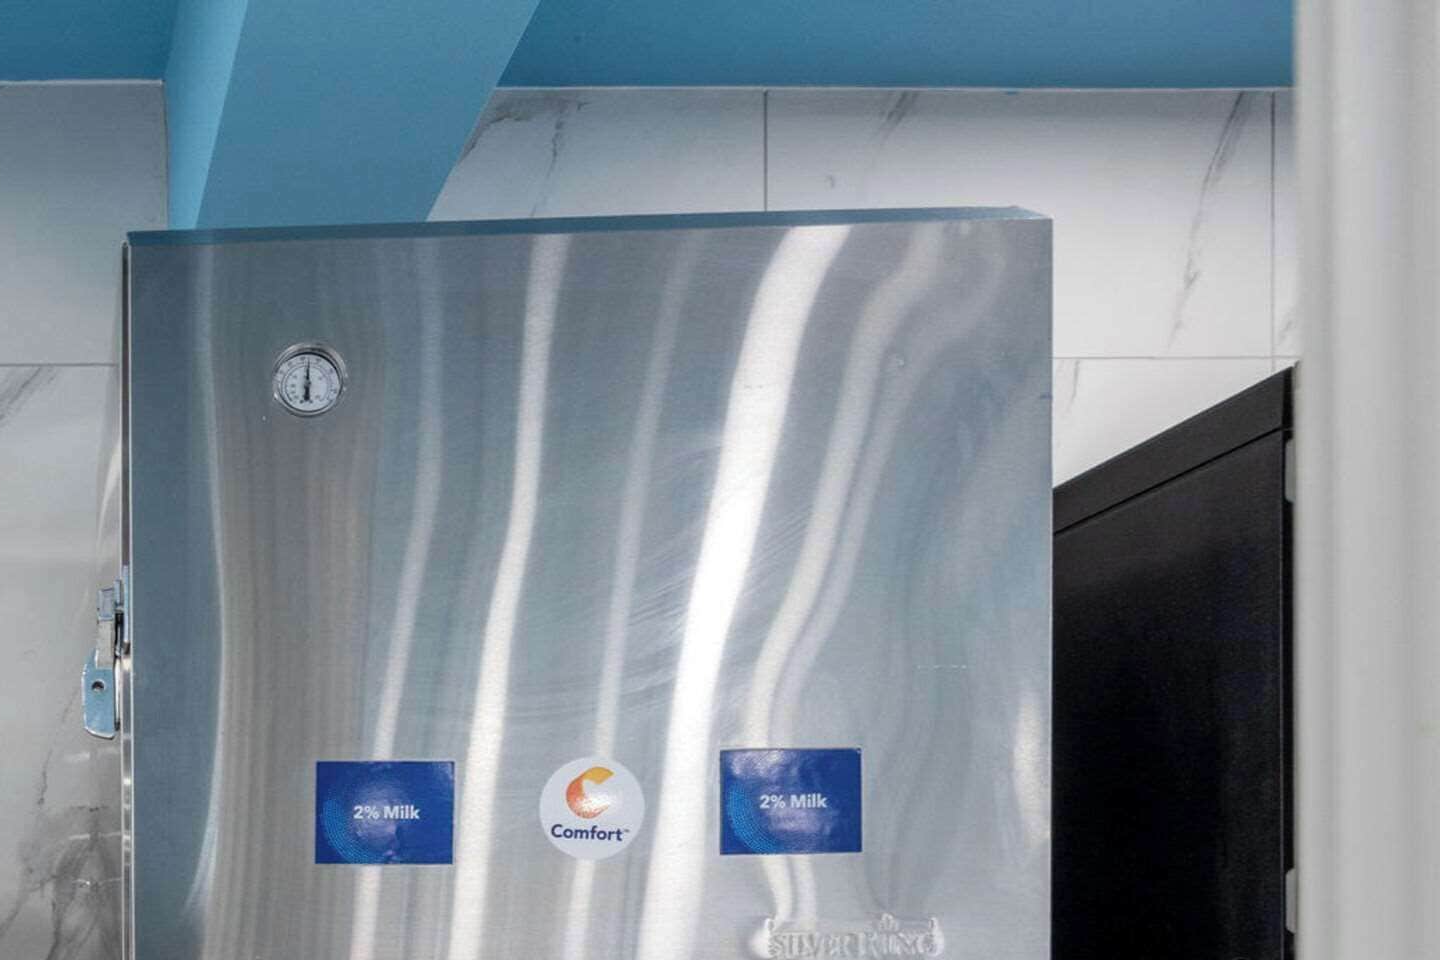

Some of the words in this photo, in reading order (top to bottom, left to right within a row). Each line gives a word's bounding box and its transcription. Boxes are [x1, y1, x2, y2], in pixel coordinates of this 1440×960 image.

[759, 793, 787, 810] 2%
[789, 793, 828, 809] Milk
[353, 804, 381, 820] 2%
[383, 804, 421, 820] Milk
